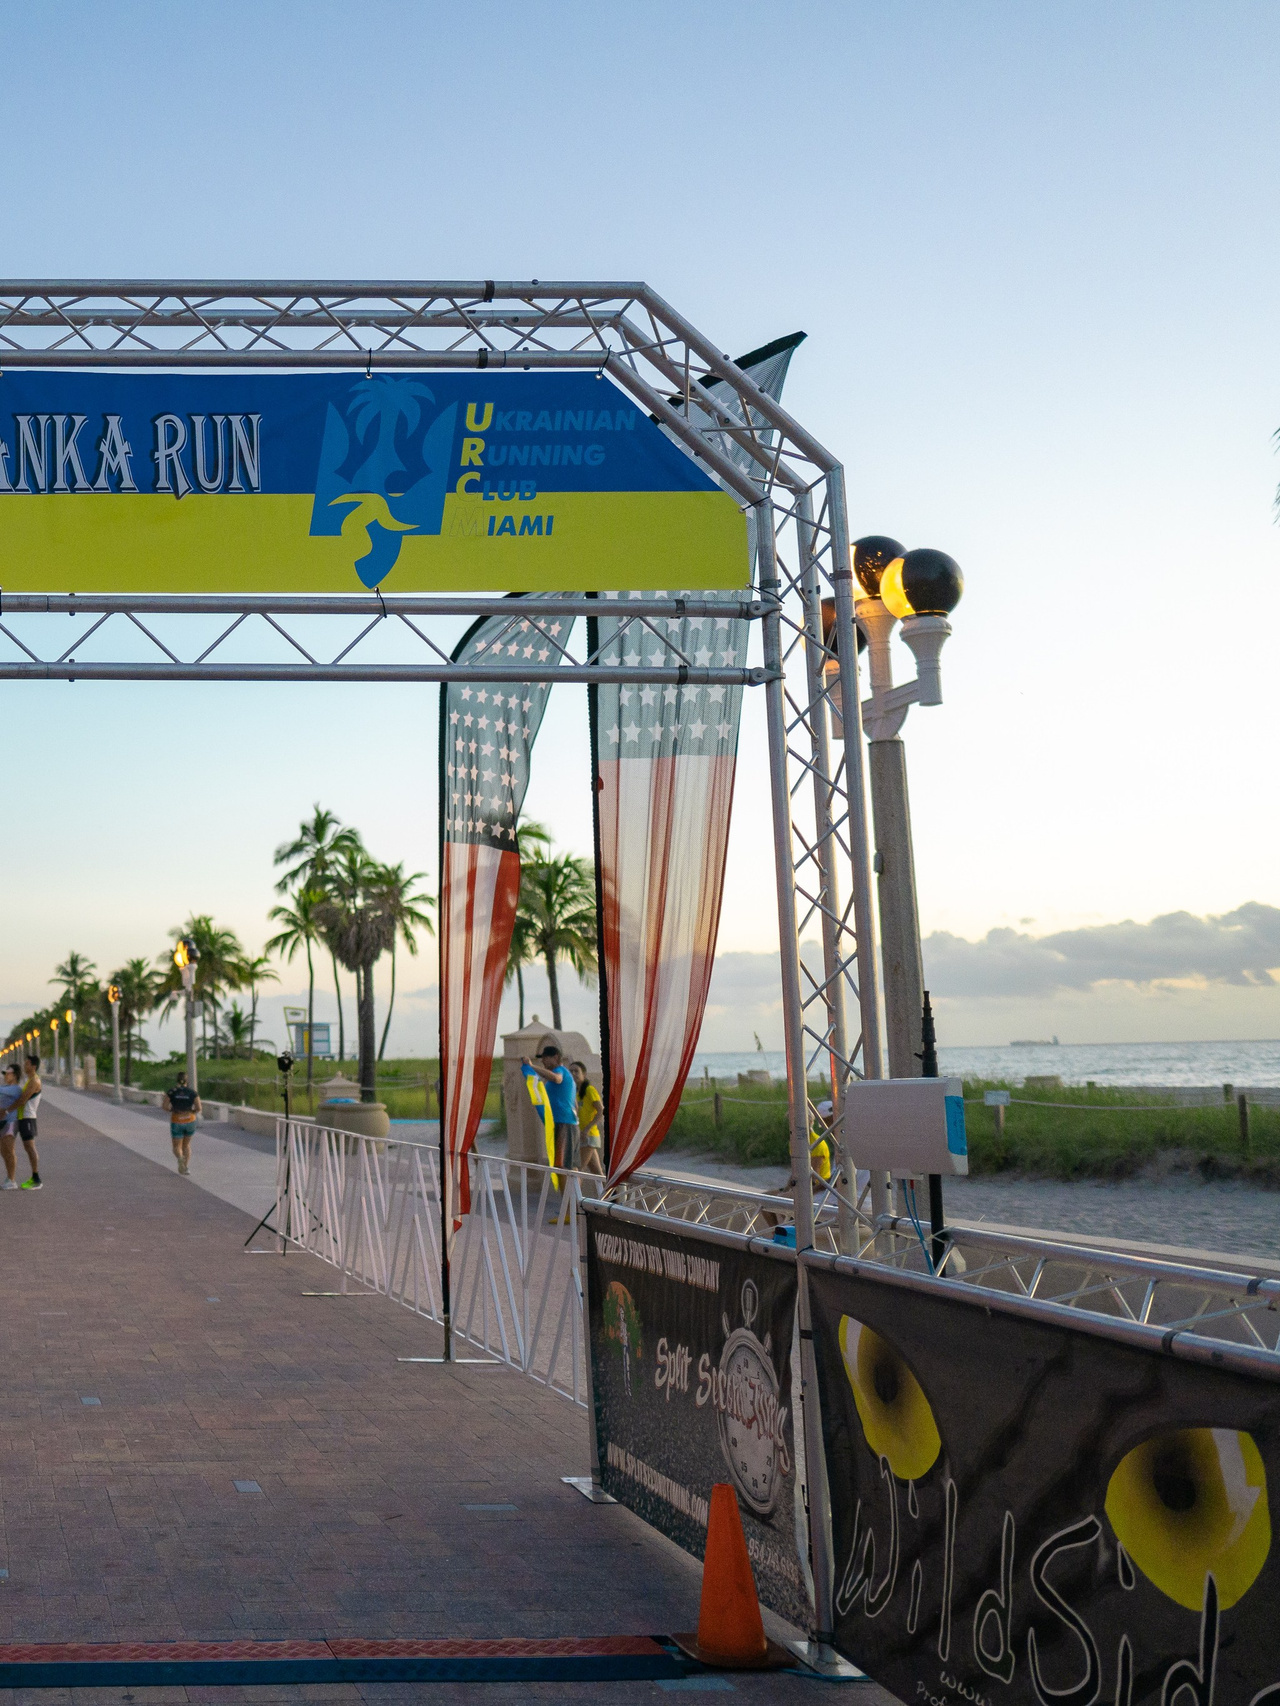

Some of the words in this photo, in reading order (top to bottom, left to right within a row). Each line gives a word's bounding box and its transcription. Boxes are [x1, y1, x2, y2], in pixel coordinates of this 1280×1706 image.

[465, 402, 637, 432] UKRAINIAN
[154, 412, 263, 500] RUN
[460, 437, 607, 466] RUNNING
[455, 471, 538, 502] CLUB
[655, 1337, 693, 1403] Split
[836, 1455, 1280, 1706] WildSid
